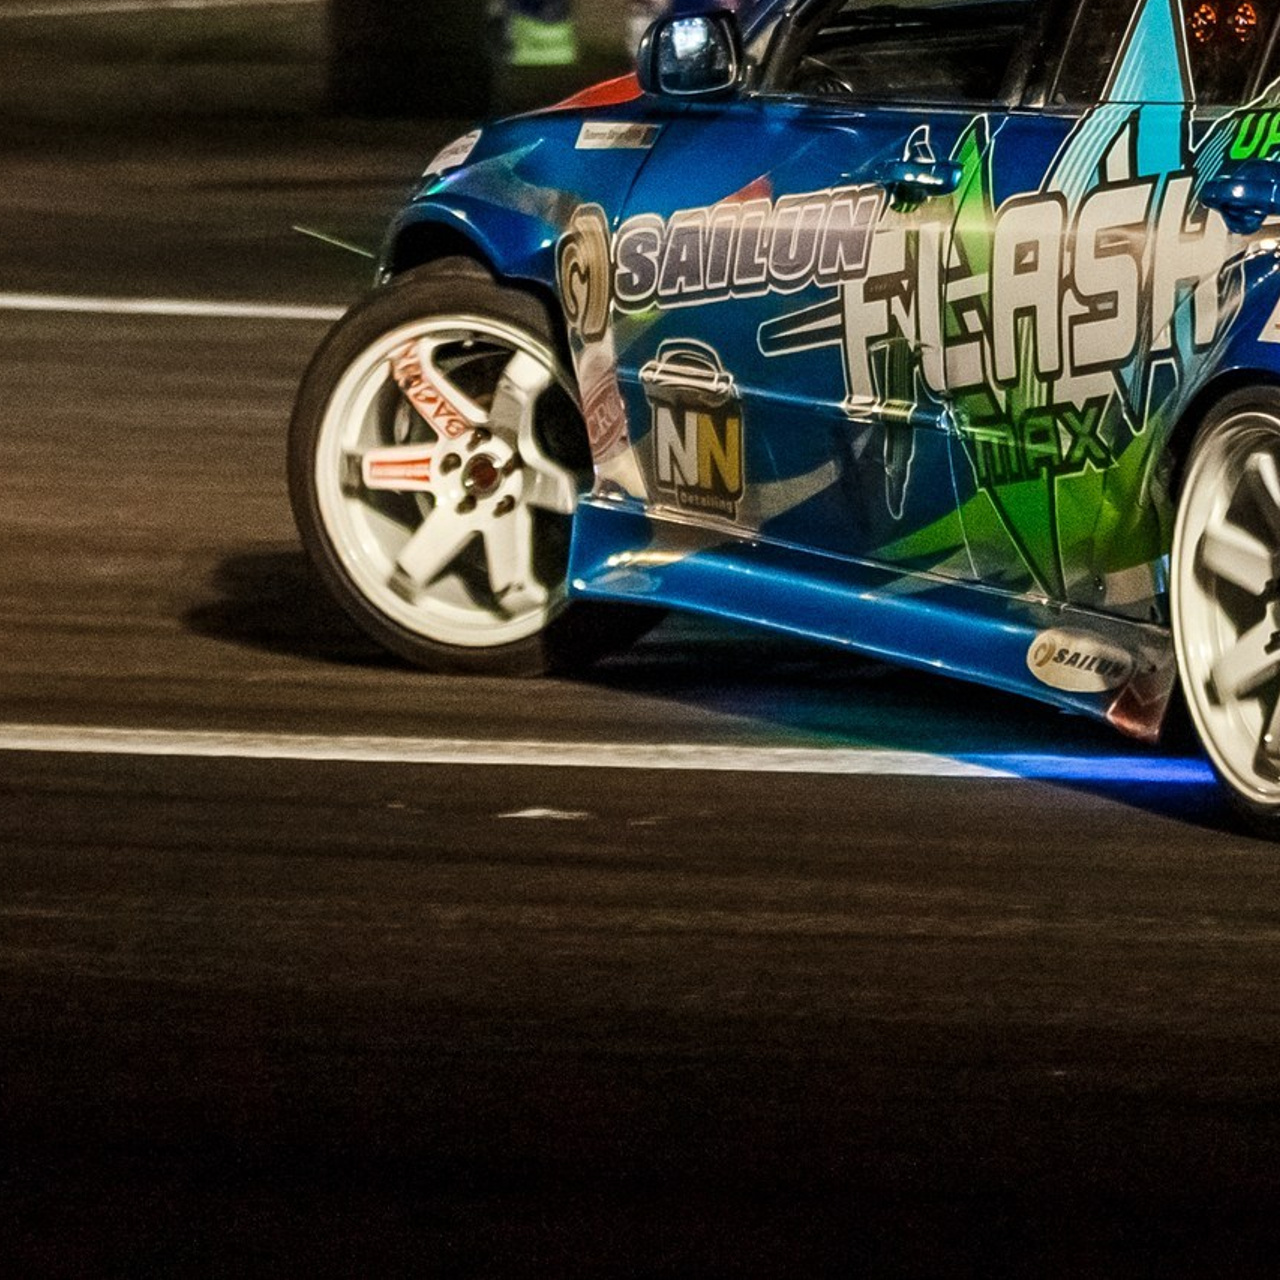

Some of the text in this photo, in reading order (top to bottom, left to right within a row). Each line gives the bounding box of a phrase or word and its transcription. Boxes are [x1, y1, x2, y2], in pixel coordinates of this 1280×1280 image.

[612, 192, 882, 305] SAILUN
[843, 177, 1230, 405] FLASH
[655, 406, 740, 494] NN
